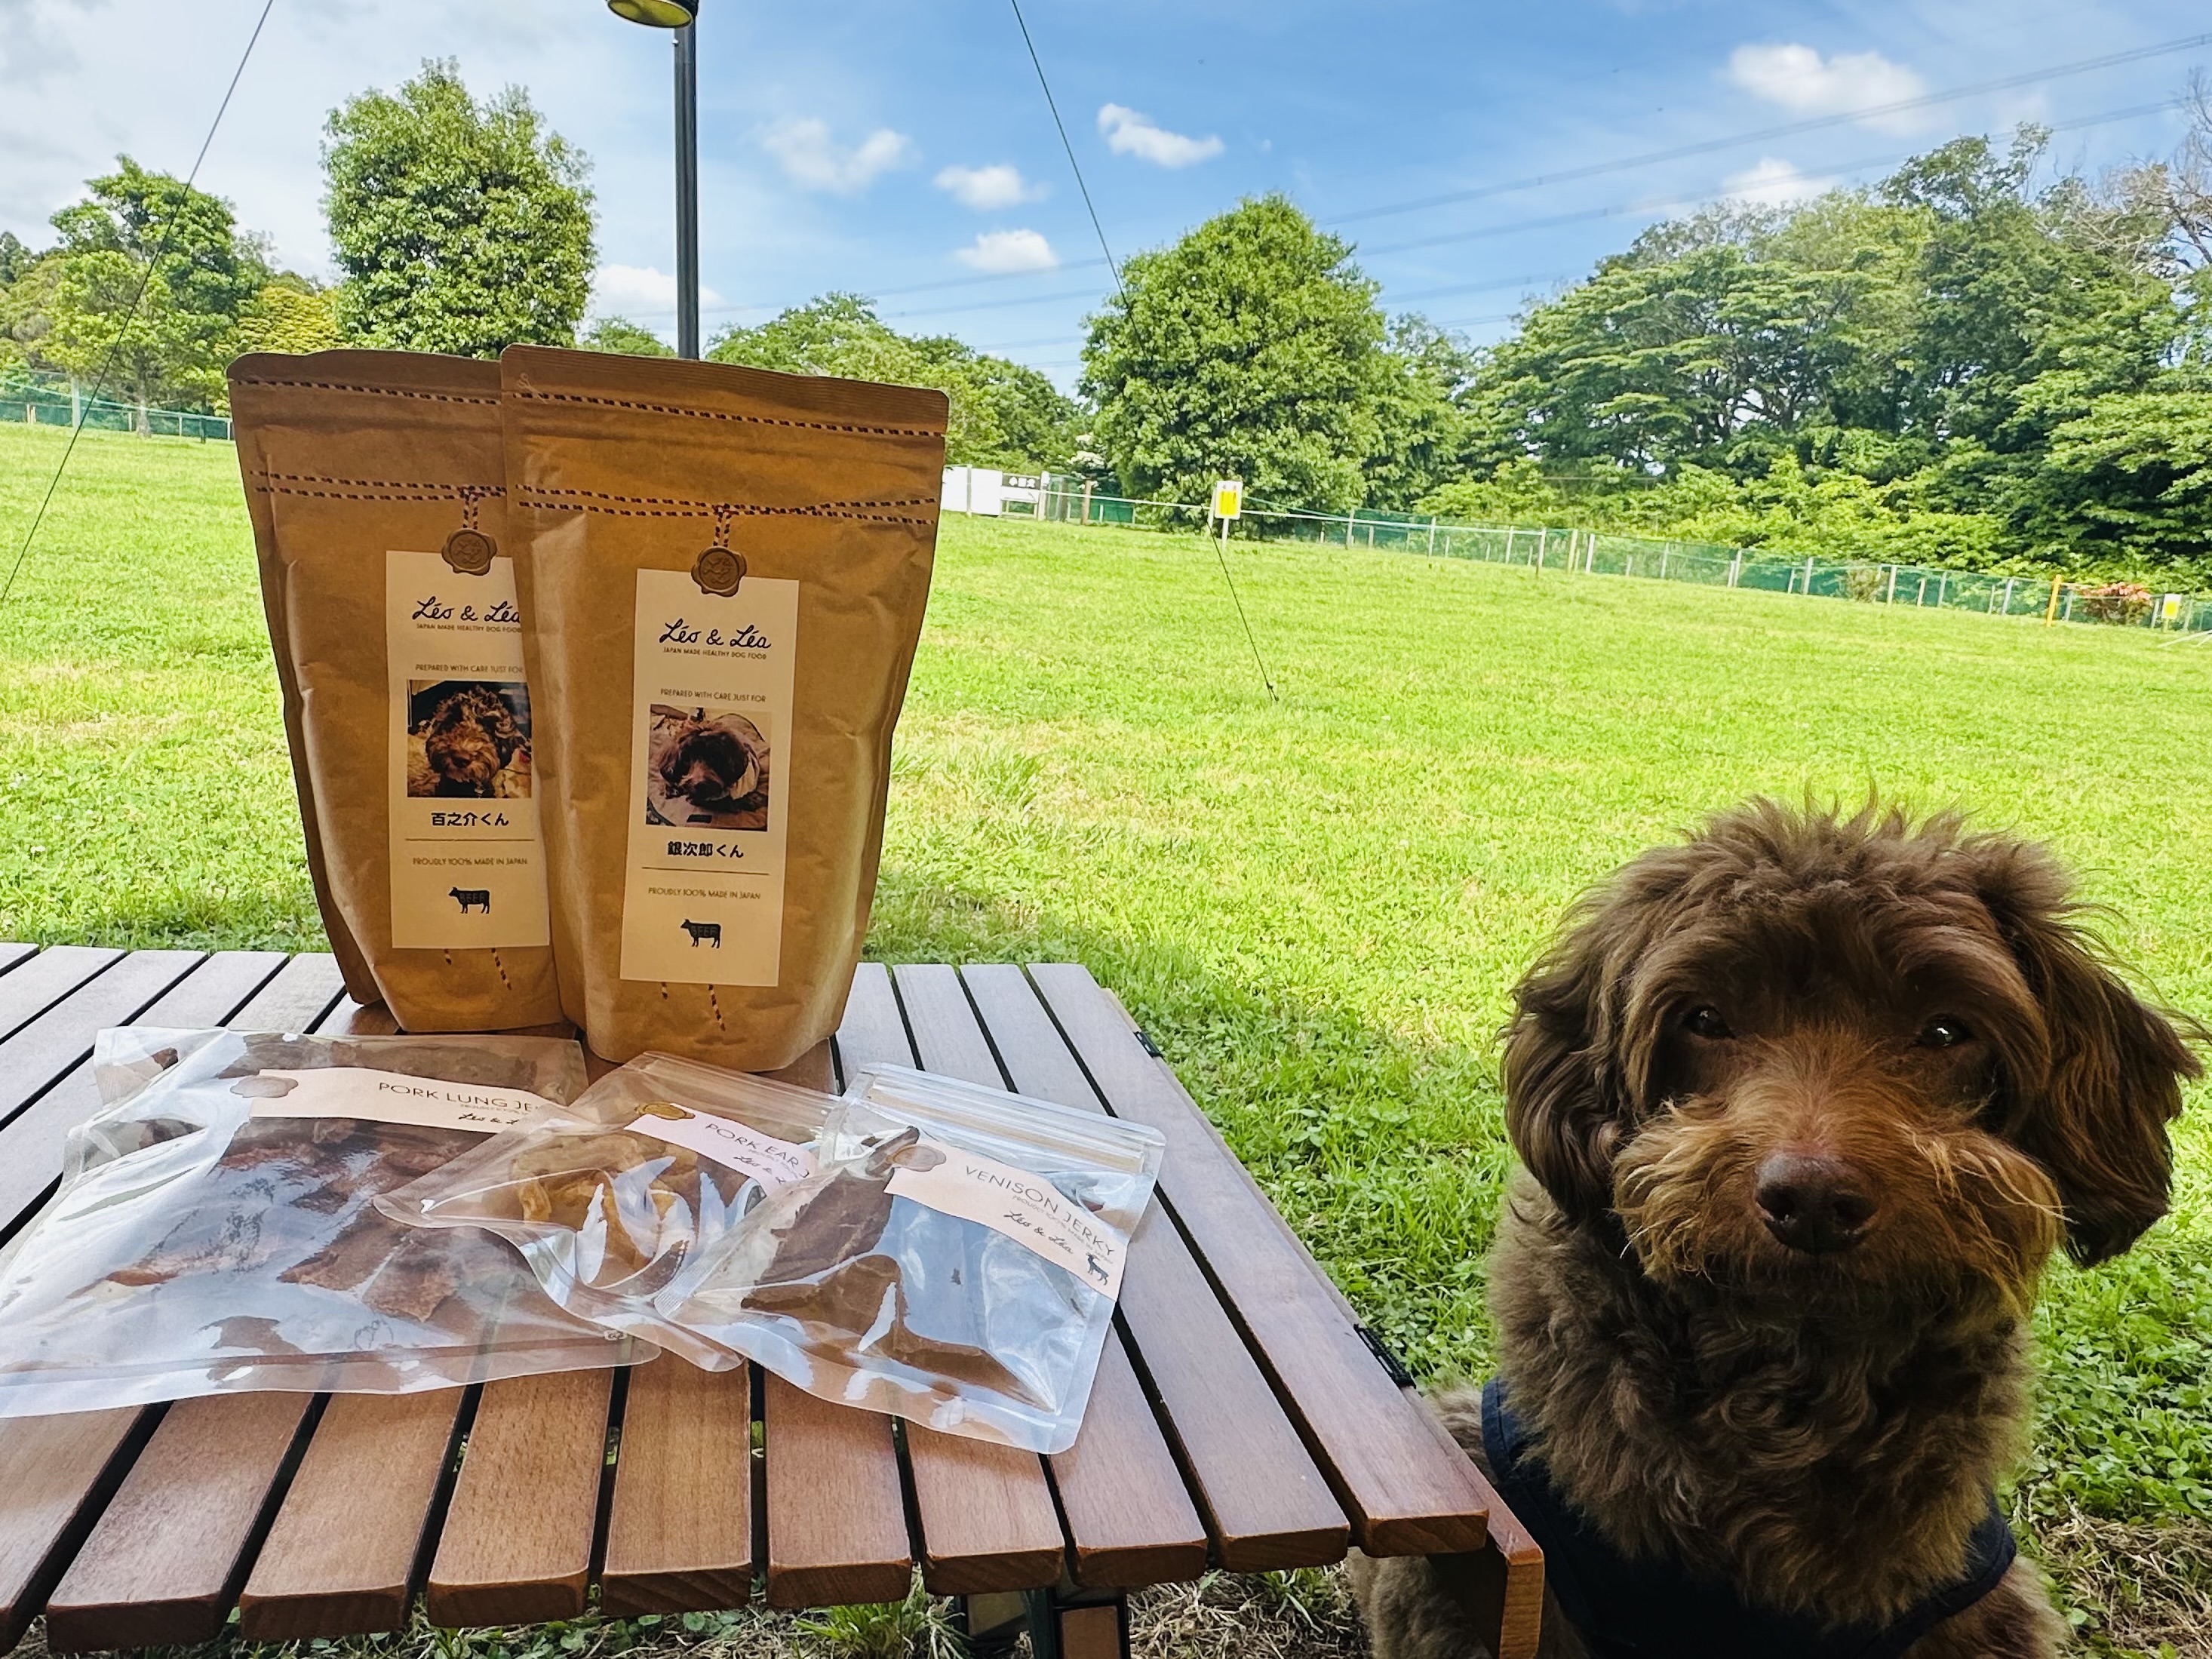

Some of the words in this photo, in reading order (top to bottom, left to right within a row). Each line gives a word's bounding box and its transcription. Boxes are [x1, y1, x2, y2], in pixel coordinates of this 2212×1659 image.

[412, 596, 455, 619] Léo
[460, 605, 478, 621] &
[484, 601, 521, 623] Léa
[659, 618, 702, 643] Léo
[706, 628, 724, 645] &
[730, 624, 772, 649] Léa
[450, 664, 469, 672] WITH
[470, 665, 488, 673] CARE
[660, 688, 693, 698] PREPARED
[694, 690, 713, 699] WITH
[713, 692, 731, 701] CARE
[733, 693, 750, 702] JUST
[751, 694, 767, 702] FOR
[430, 812, 509, 827] 百之介くん
[667, 840, 745, 859] 銀次郎くん
[413, 857, 447, 866] PROUDLY
[448, 858, 472, 866] 100%
[474, 858, 494, 866] MADE
[648, 886, 682, 896] PROUDLY
[683, 889, 707, 898] 100%
[708, 889, 728, 899] MADE
[739, 891, 761, 899] JAPAN
[379, 1082, 439, 1100] PORK
[447, 1092, 508, 1108] LUNG
[705, 1123, 761, 1150] PORK
[765, 1145, 799, 1169] EAR
[966, 1165, 1058, 1214] VENISON
[1063, 1211, 1115, 1256] JERKY
[1034, 1226, 1046, 1237] &
